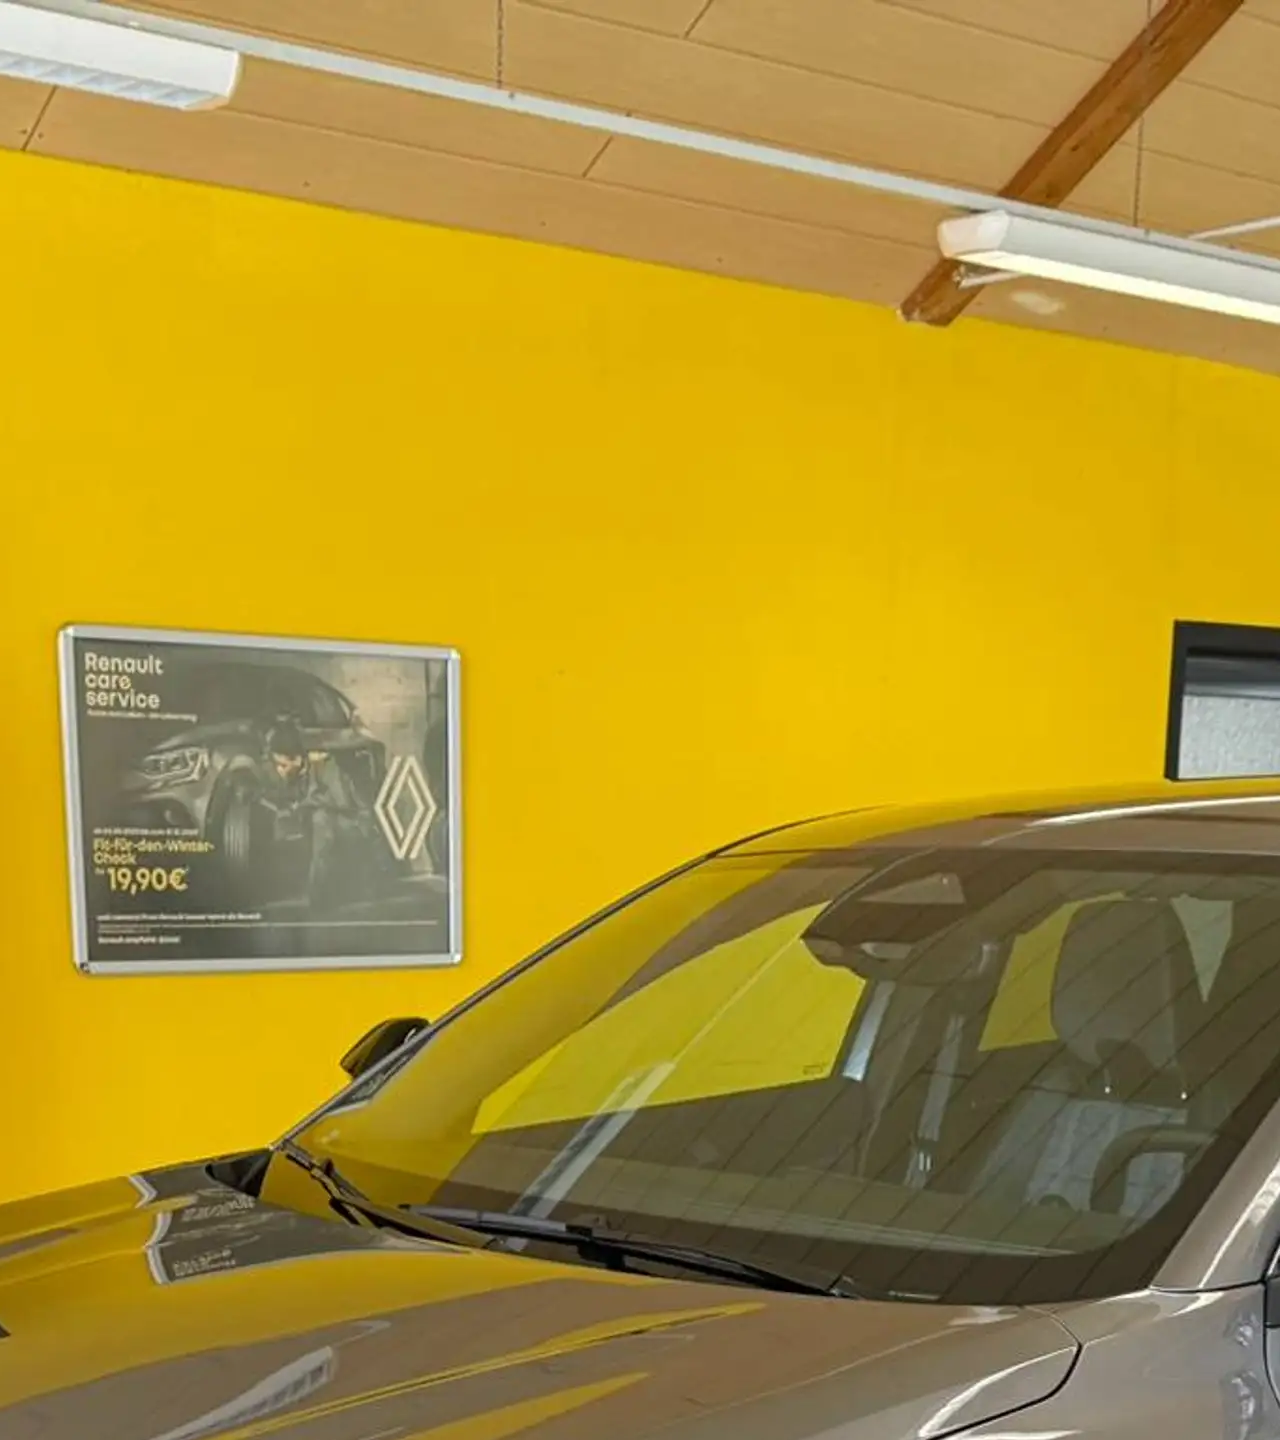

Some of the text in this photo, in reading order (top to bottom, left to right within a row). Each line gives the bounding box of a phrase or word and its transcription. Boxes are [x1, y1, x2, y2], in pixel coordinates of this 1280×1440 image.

[84, 651, 164, 676] Renault
[85, 674, 132, 692] care
[85, 690, 161, 709] service
